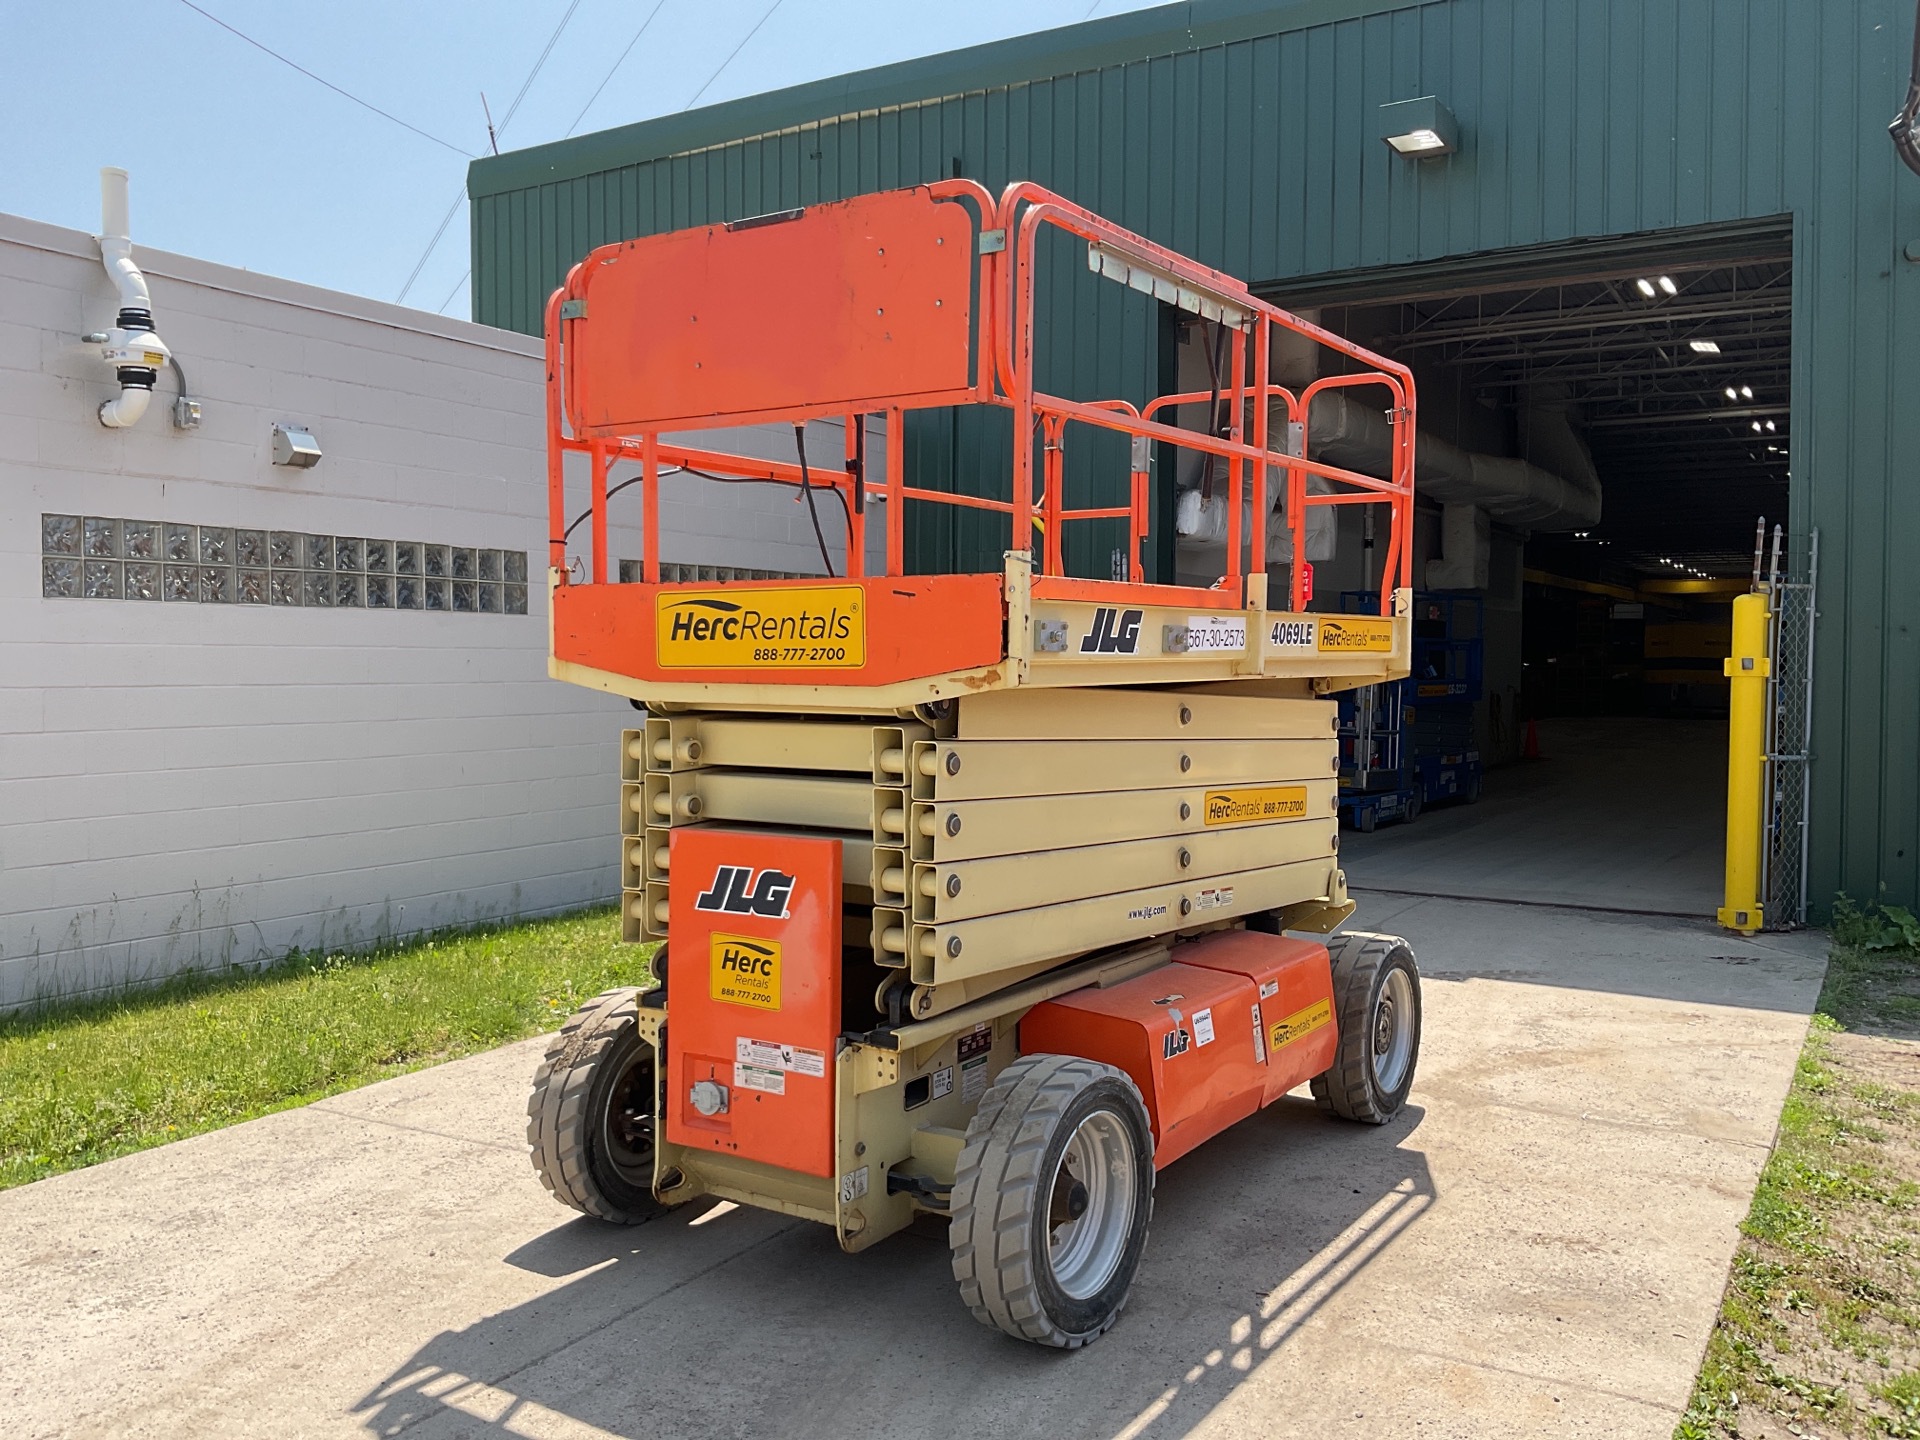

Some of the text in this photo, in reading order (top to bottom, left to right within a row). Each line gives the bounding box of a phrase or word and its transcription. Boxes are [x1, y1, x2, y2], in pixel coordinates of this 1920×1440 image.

[671, 608, 850, 641] HercRentals
[1082, 607, 1144, 655] JLG
[1271, 622, 1314, 647] 4069LE
[1189, 629, 1245, 648] 567-30-2573
[1322, 629, 1368, 647] HercRentals
[753, 646, 846, 661] 888-777-2700
[1209, 799, 1260, 819] HercRentals
[1263, 800, 1304, 815] 888-777-2700
[698, 866, 795, 918] JLG
[721, 948, 773, 976] Herc
[734, 974, 770, 990] Rentals
[720, 987, 772, 1004] 888-777-2700
[1273, 1017, 1311, 1046] HercRentals
